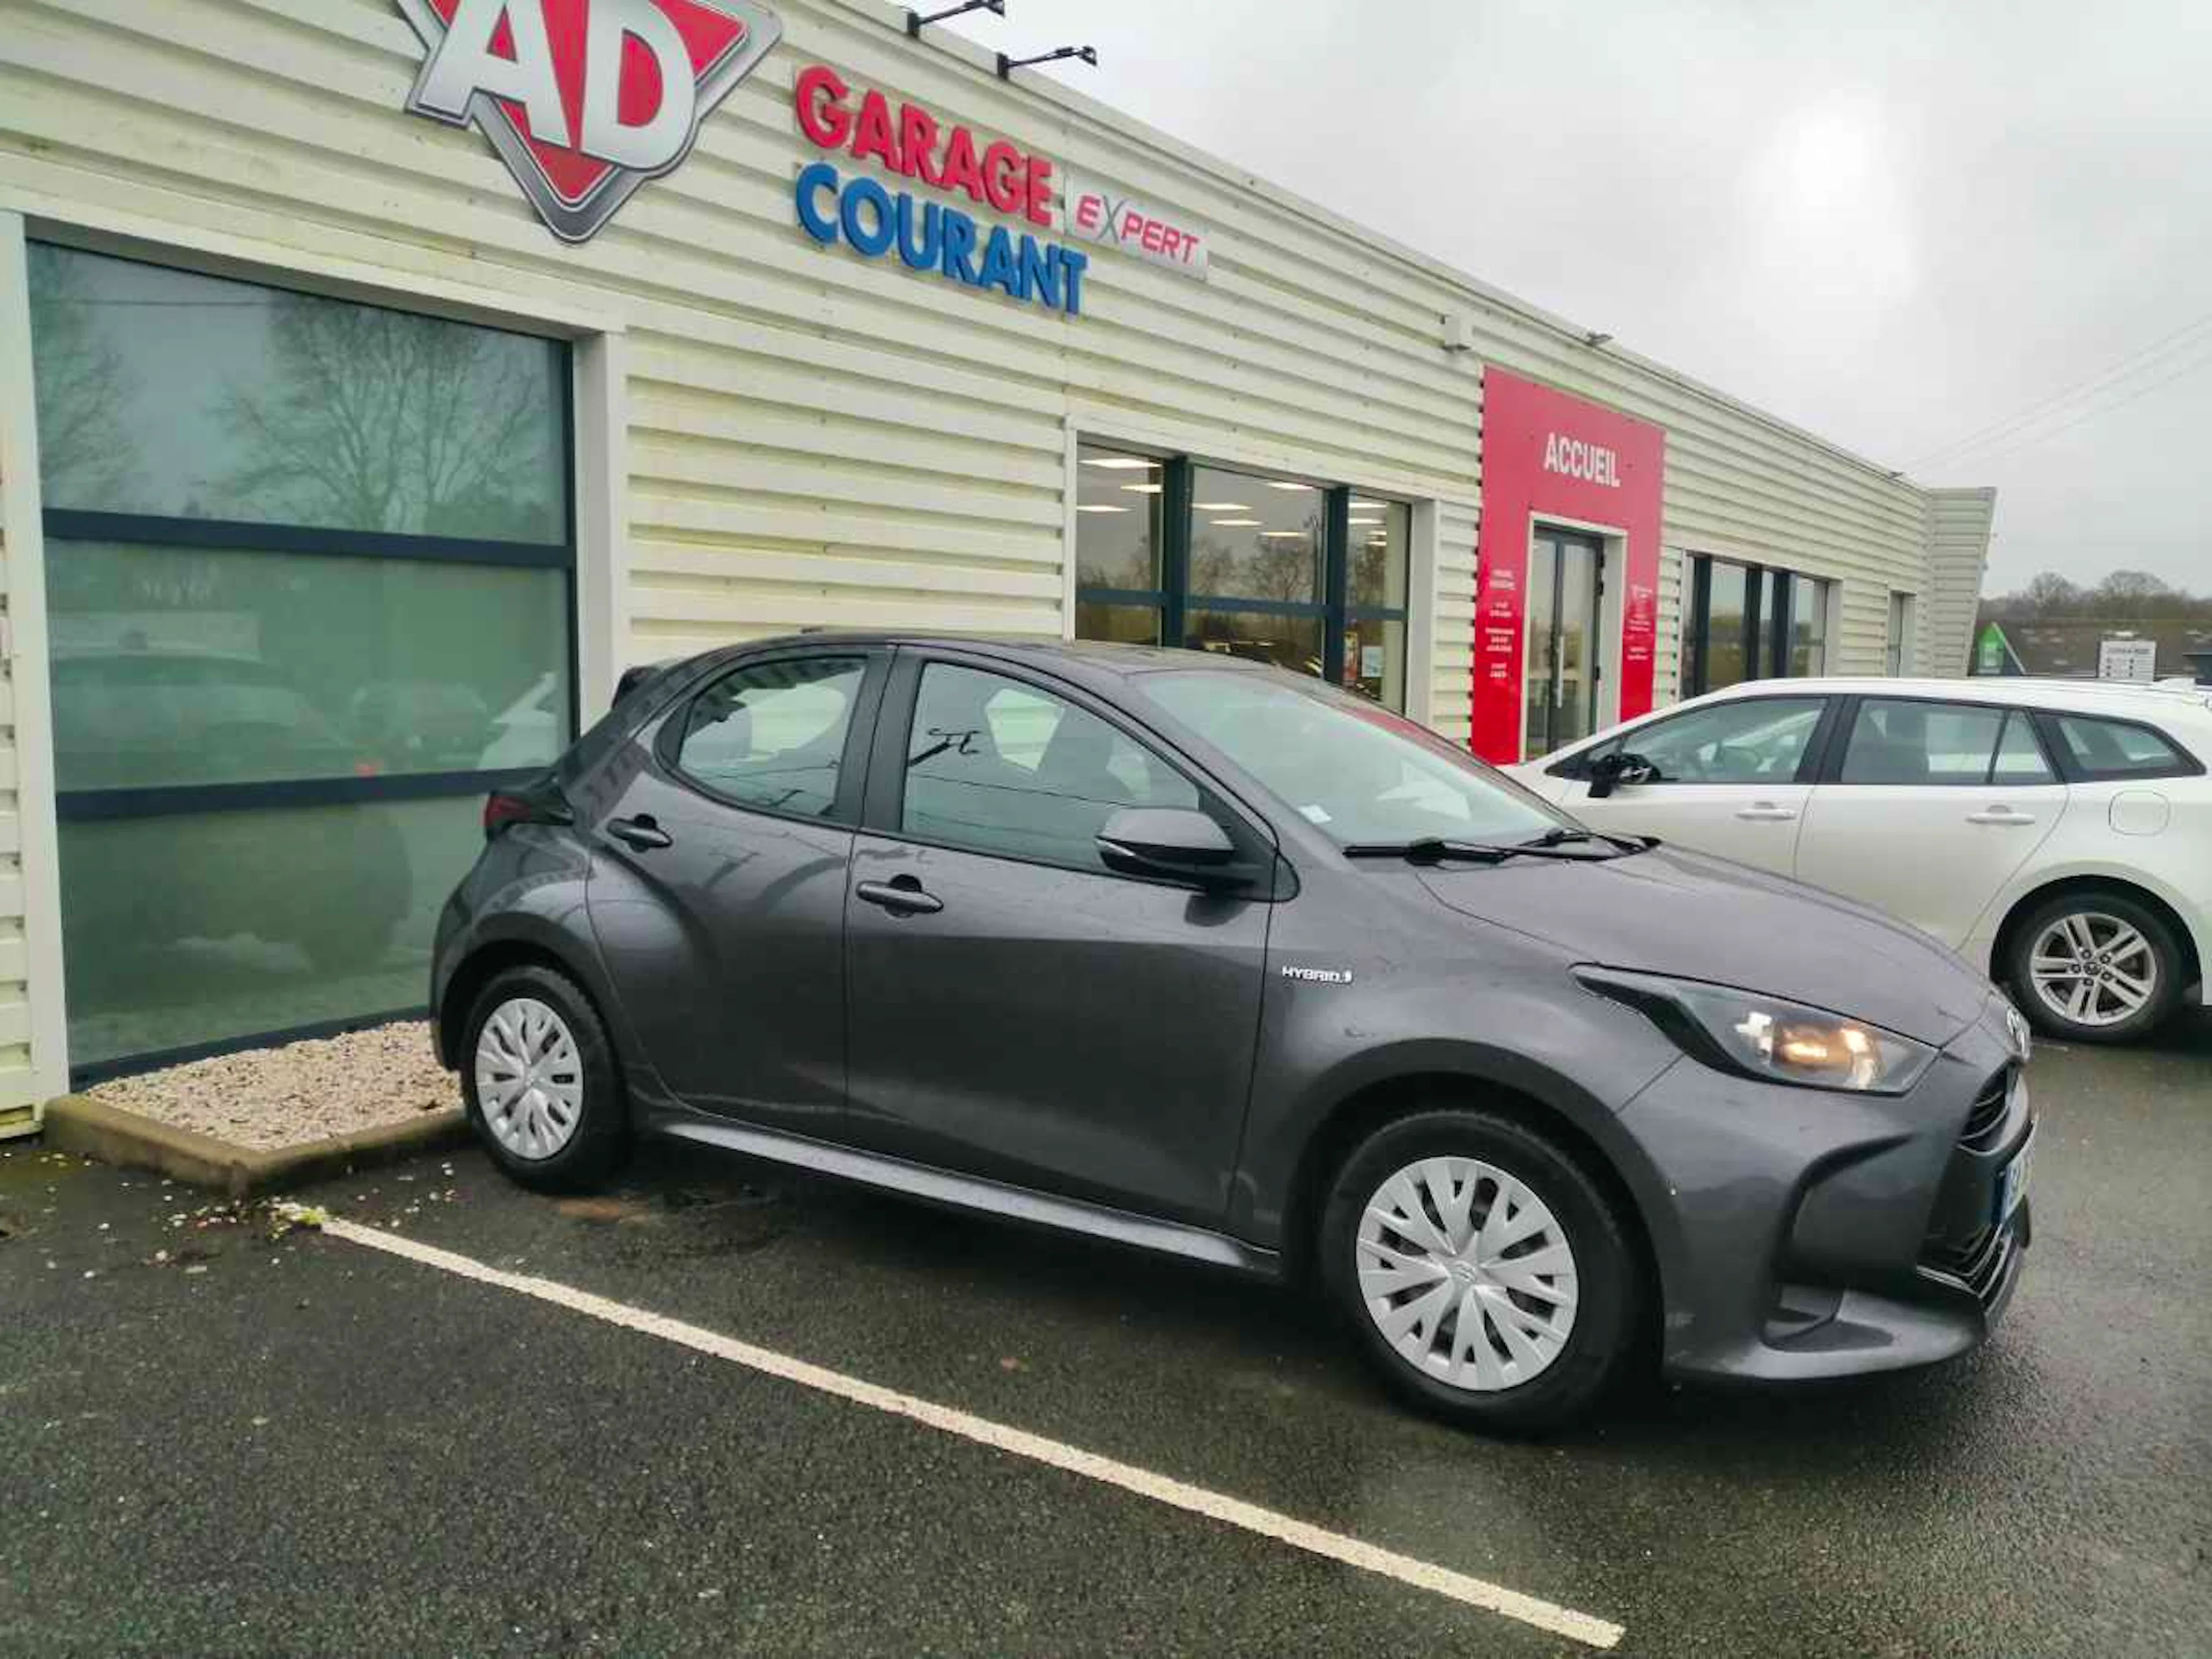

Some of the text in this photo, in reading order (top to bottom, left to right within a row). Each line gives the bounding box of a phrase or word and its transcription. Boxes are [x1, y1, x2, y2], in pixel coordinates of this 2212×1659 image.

[419, 0, 695, 169] AD
[796, 65, 1053, 227] GARAGE
[796, 161, 1088, 316] COURANT
[1543, 433, 1621, 487] ACCUEIL
[1282, 966, 1340, 983] HYBRID
